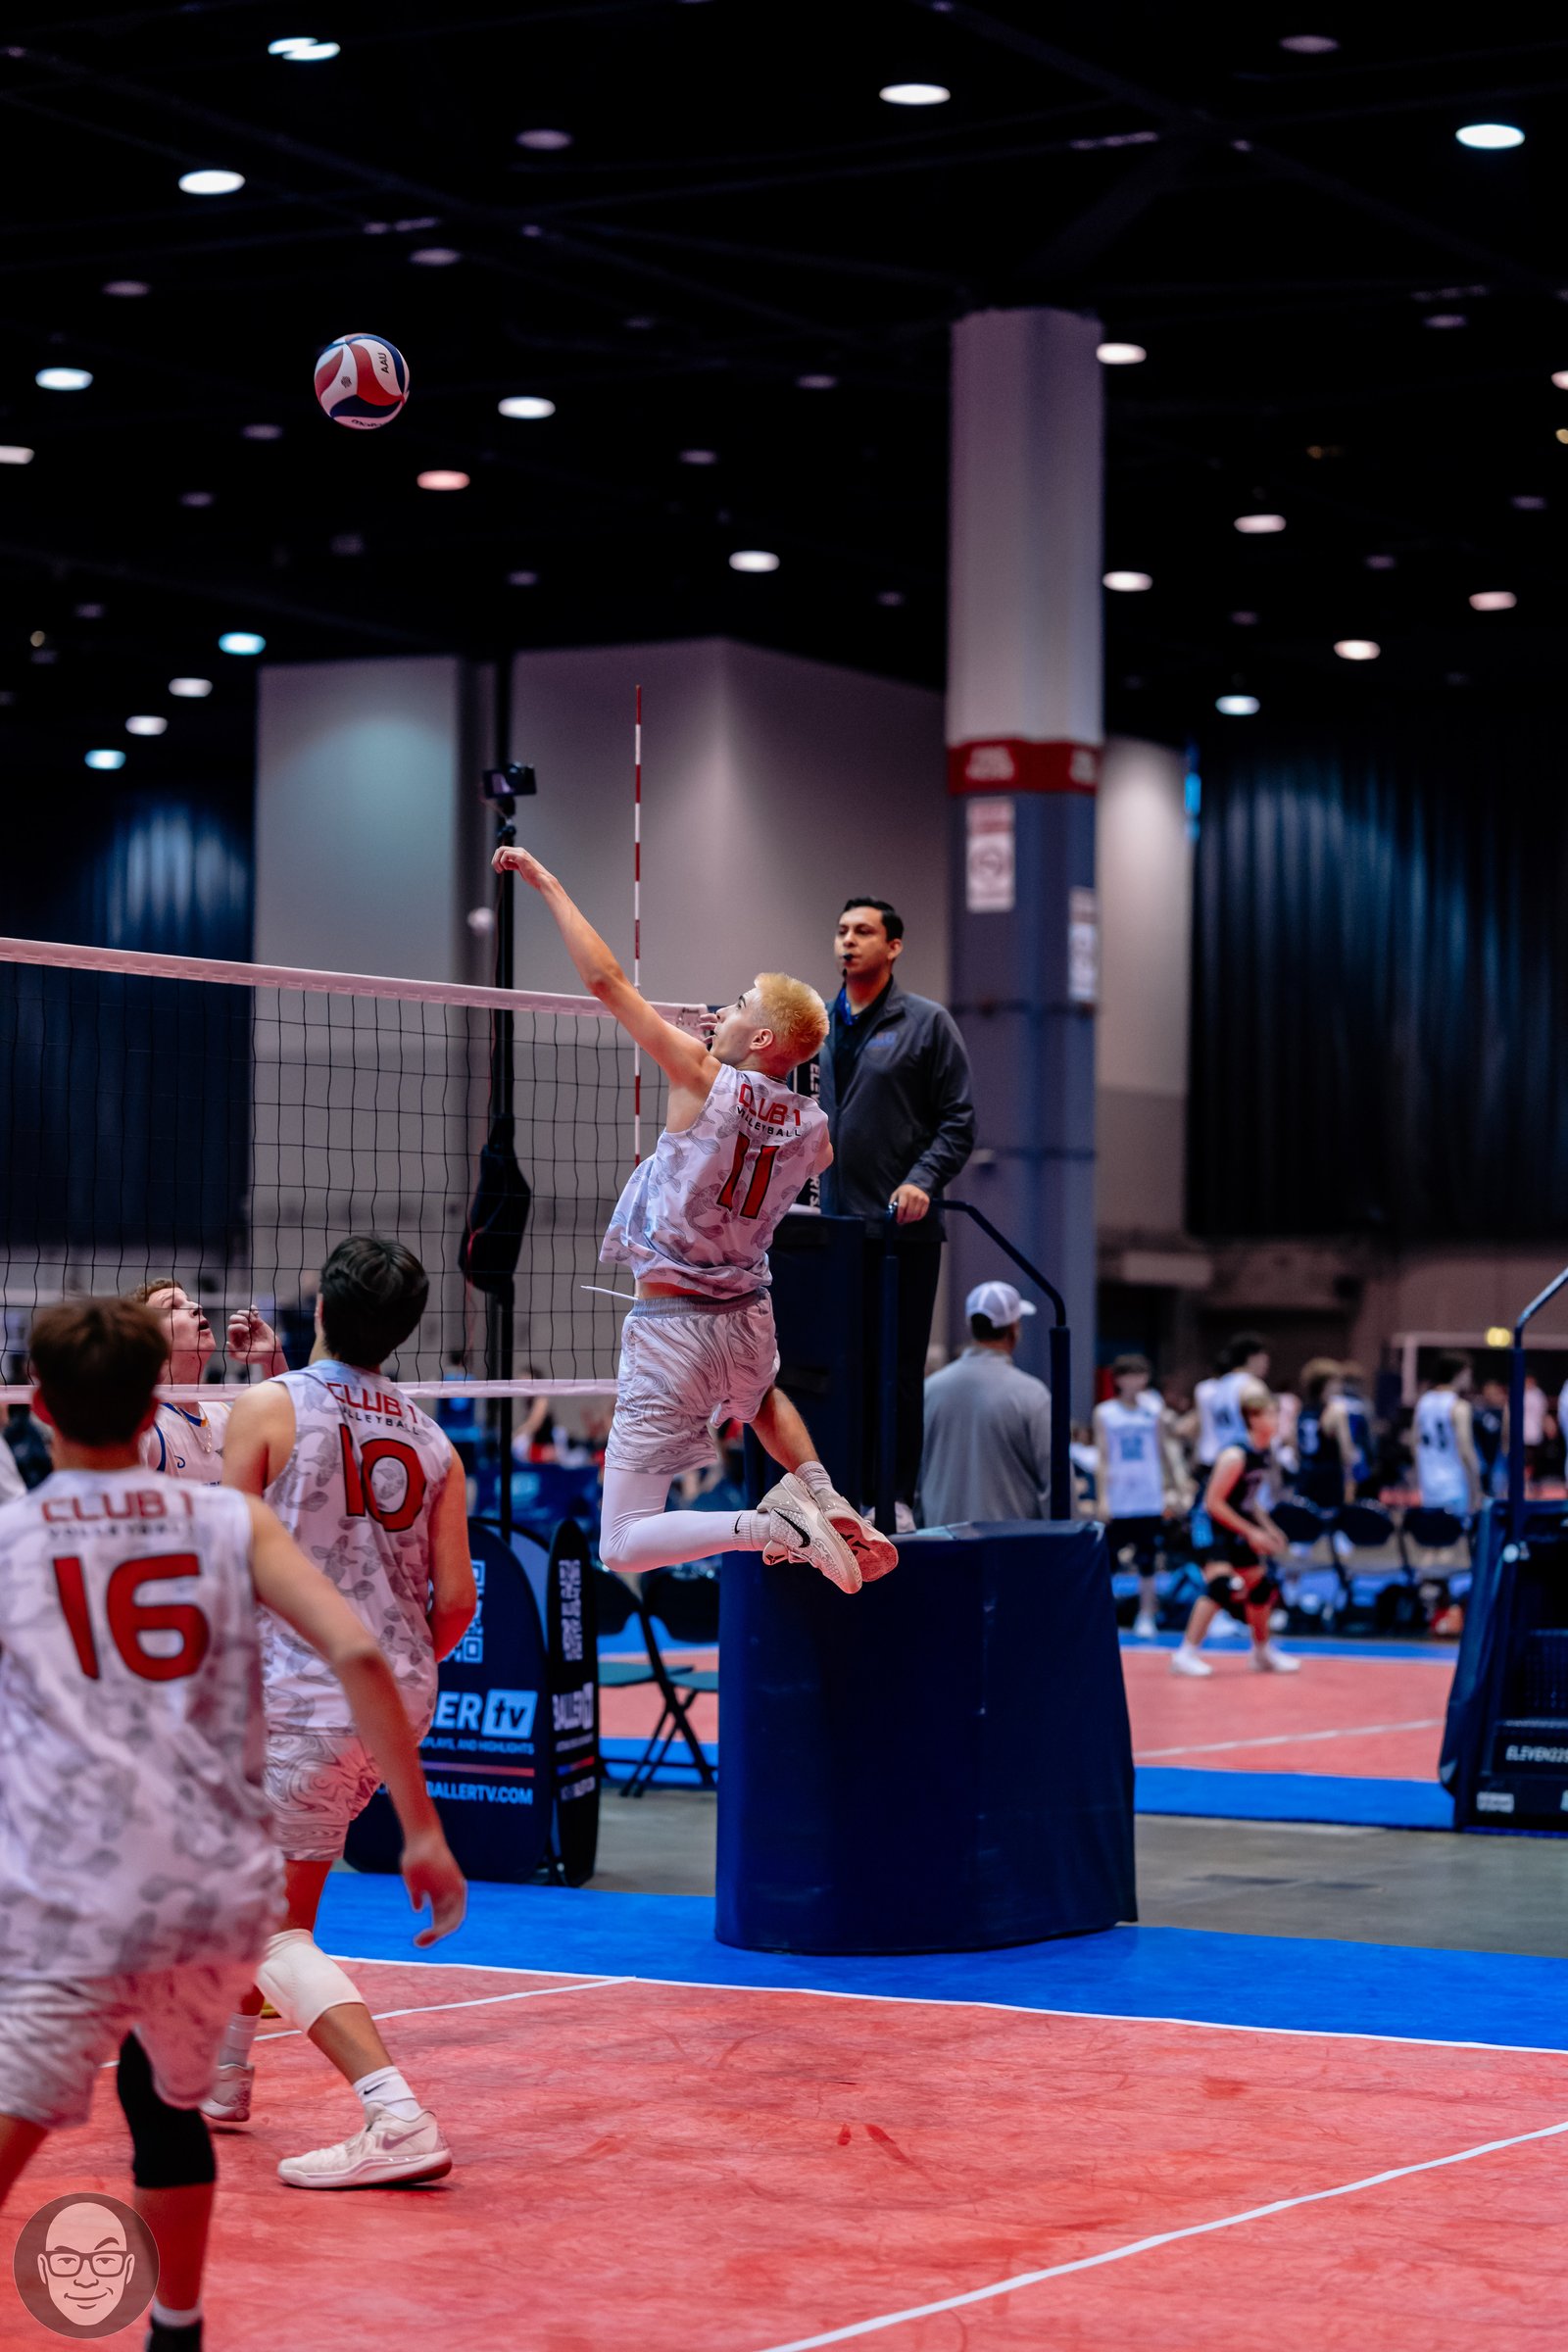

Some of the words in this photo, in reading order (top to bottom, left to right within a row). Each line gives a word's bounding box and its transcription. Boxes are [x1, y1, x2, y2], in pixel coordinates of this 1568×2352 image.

[377, 352, 390, 374] AAU
[739, 1083, 789, 1126] CLUB
[793, 1108, 802, 1127] 1
[716, 1131, 780, 1220] 11
[326, 1383, 403, 1417] CLUB
[407, 1404, 418, 1424] 1
[343, 1407, 419, 1436] LLEYBALL
[339, 1423, 427, 1533] 10
[41, 1490, 168, 1523] CLUB
[180, 1491, 194, 1519] 1
[53, 1553, 210, 1683] 16
